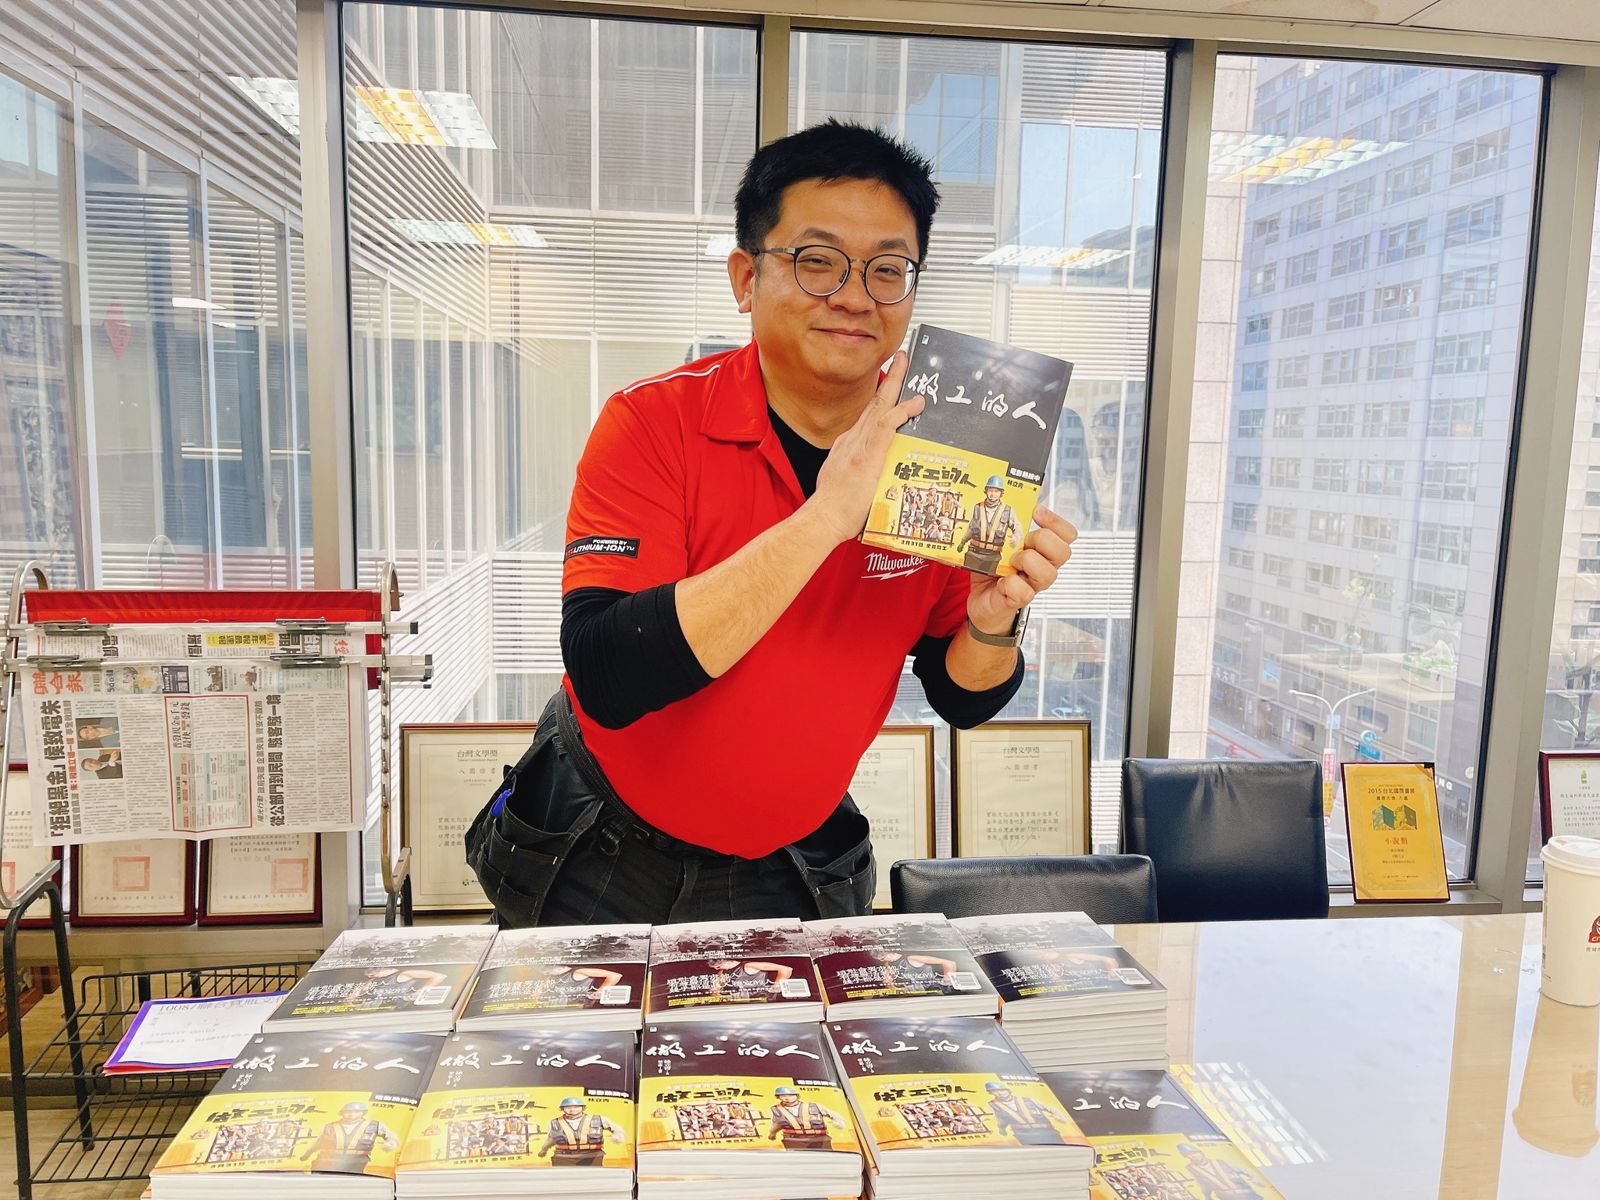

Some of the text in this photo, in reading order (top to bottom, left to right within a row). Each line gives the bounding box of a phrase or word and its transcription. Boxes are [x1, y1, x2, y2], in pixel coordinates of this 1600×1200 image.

[894, 462, 977, 488] 做工的人
[32, 671, 84, 695] 聯合報
[268, 751, 285, 827] 從公部門到民間
